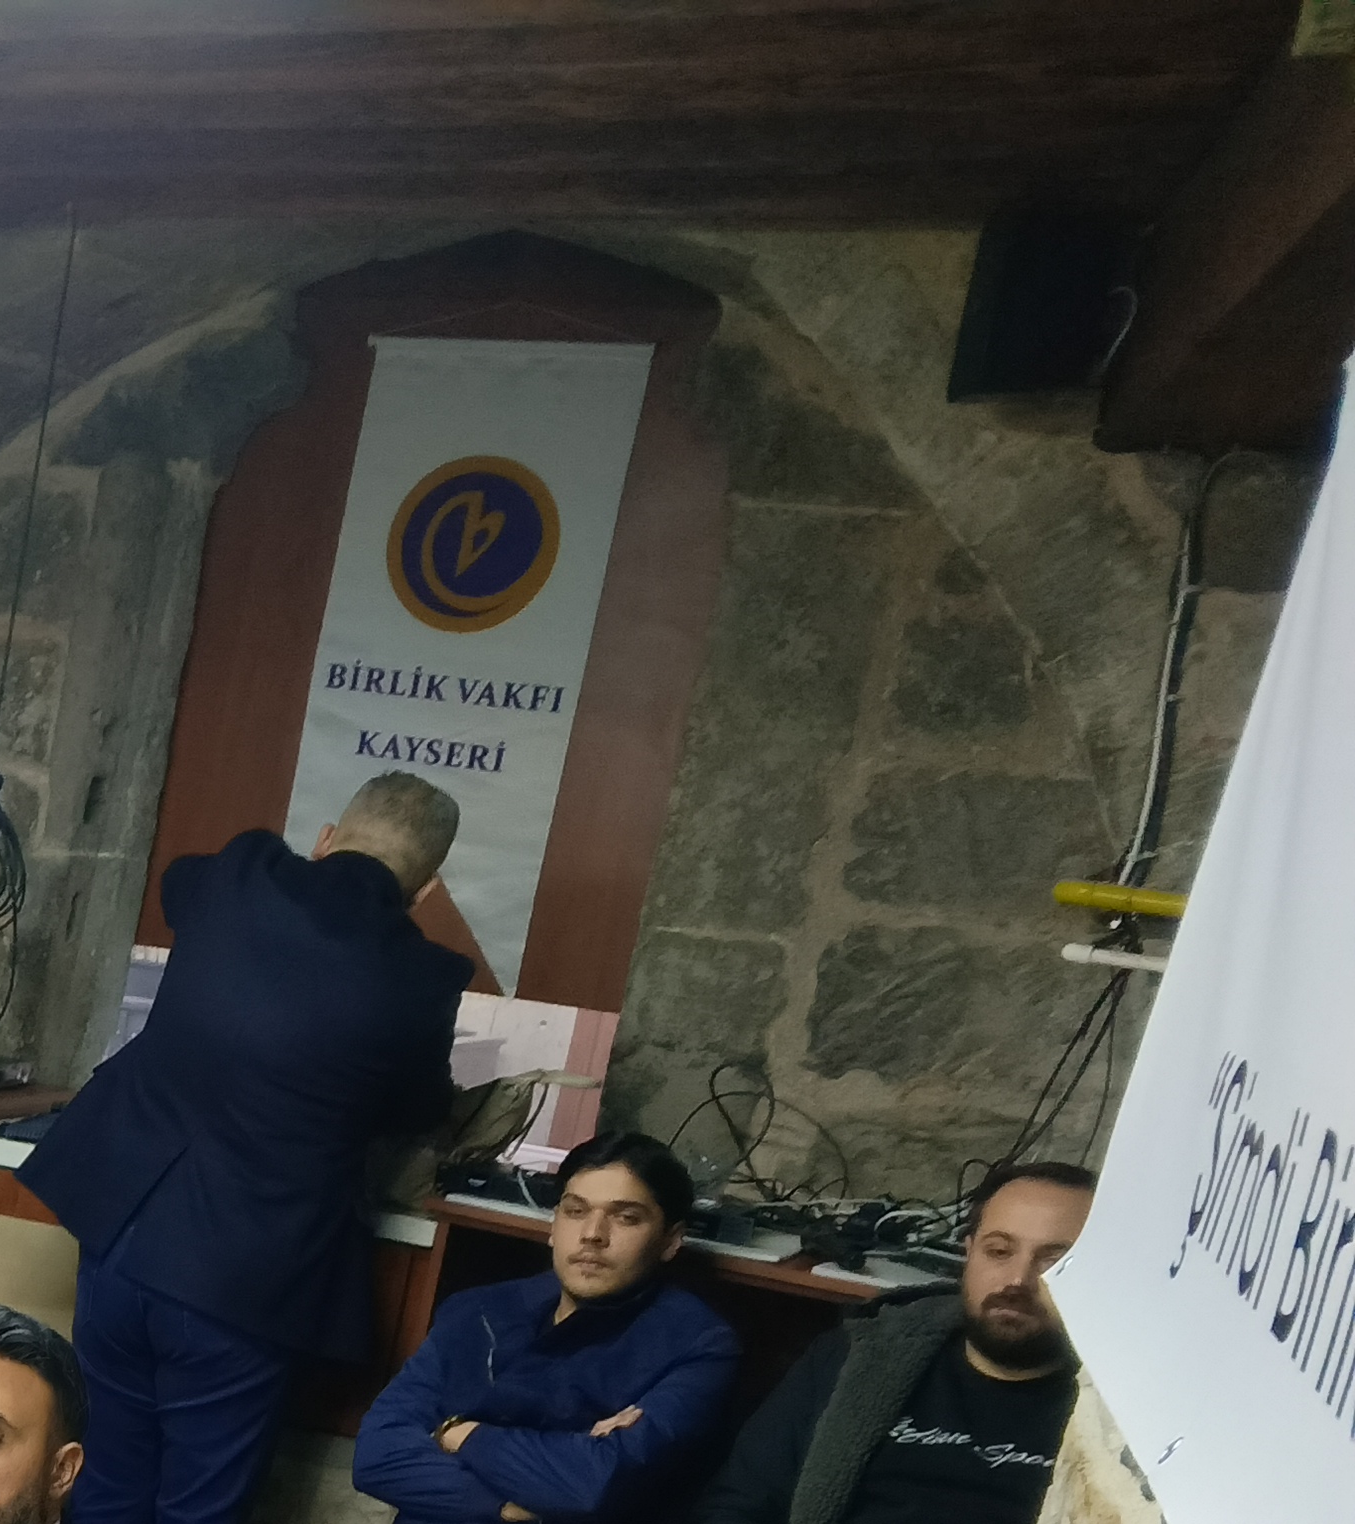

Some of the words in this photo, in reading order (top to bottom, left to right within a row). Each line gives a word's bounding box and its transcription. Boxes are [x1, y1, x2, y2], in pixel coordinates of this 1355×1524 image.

[325, 658, 450, 702] BİRLİK
[457, 677, 566, 713] VAKFI
[355, 729, 506, 773] KAYSERİ
